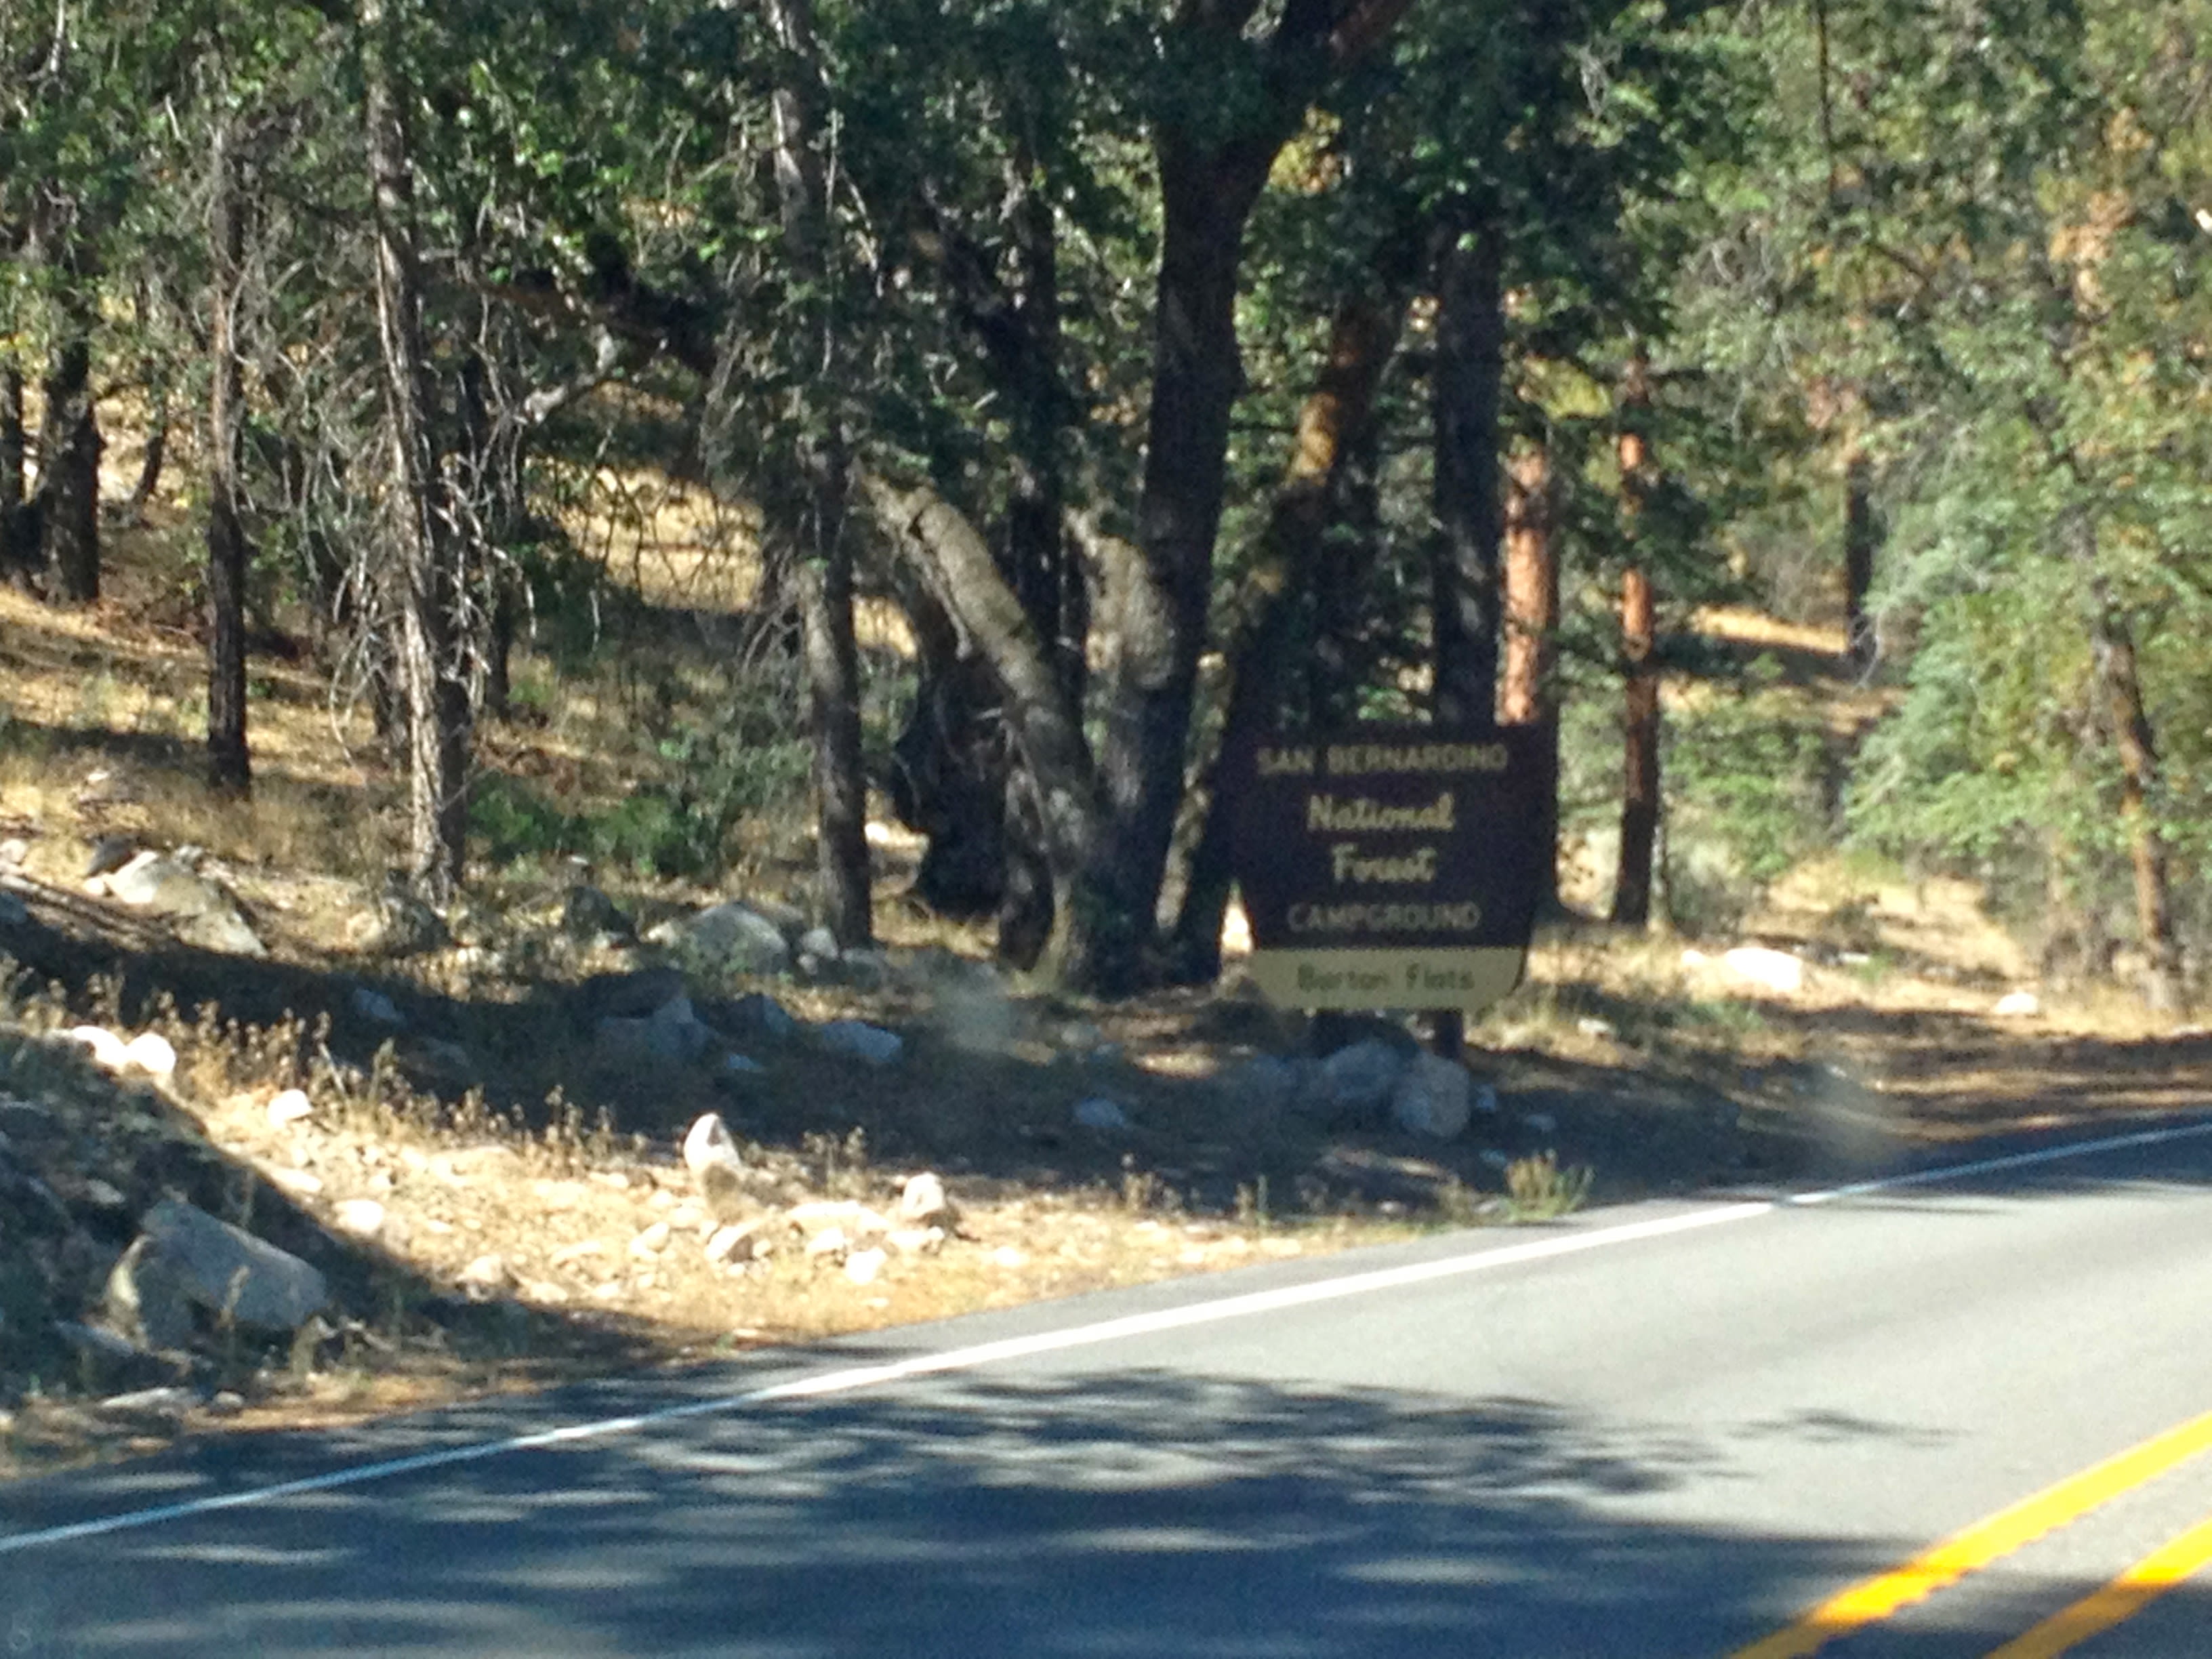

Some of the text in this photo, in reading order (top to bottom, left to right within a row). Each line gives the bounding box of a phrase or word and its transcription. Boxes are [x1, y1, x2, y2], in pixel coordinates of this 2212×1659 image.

[1257, 744, 1508, 775] SAN BERNARDINO
[1307, 792, 1455, 831] National
[1332, 843, 1437, 881] Forest
[1288, 901, 1481, 932] CAMPGROUND
[1406, 962, 1475, 990] Flats
